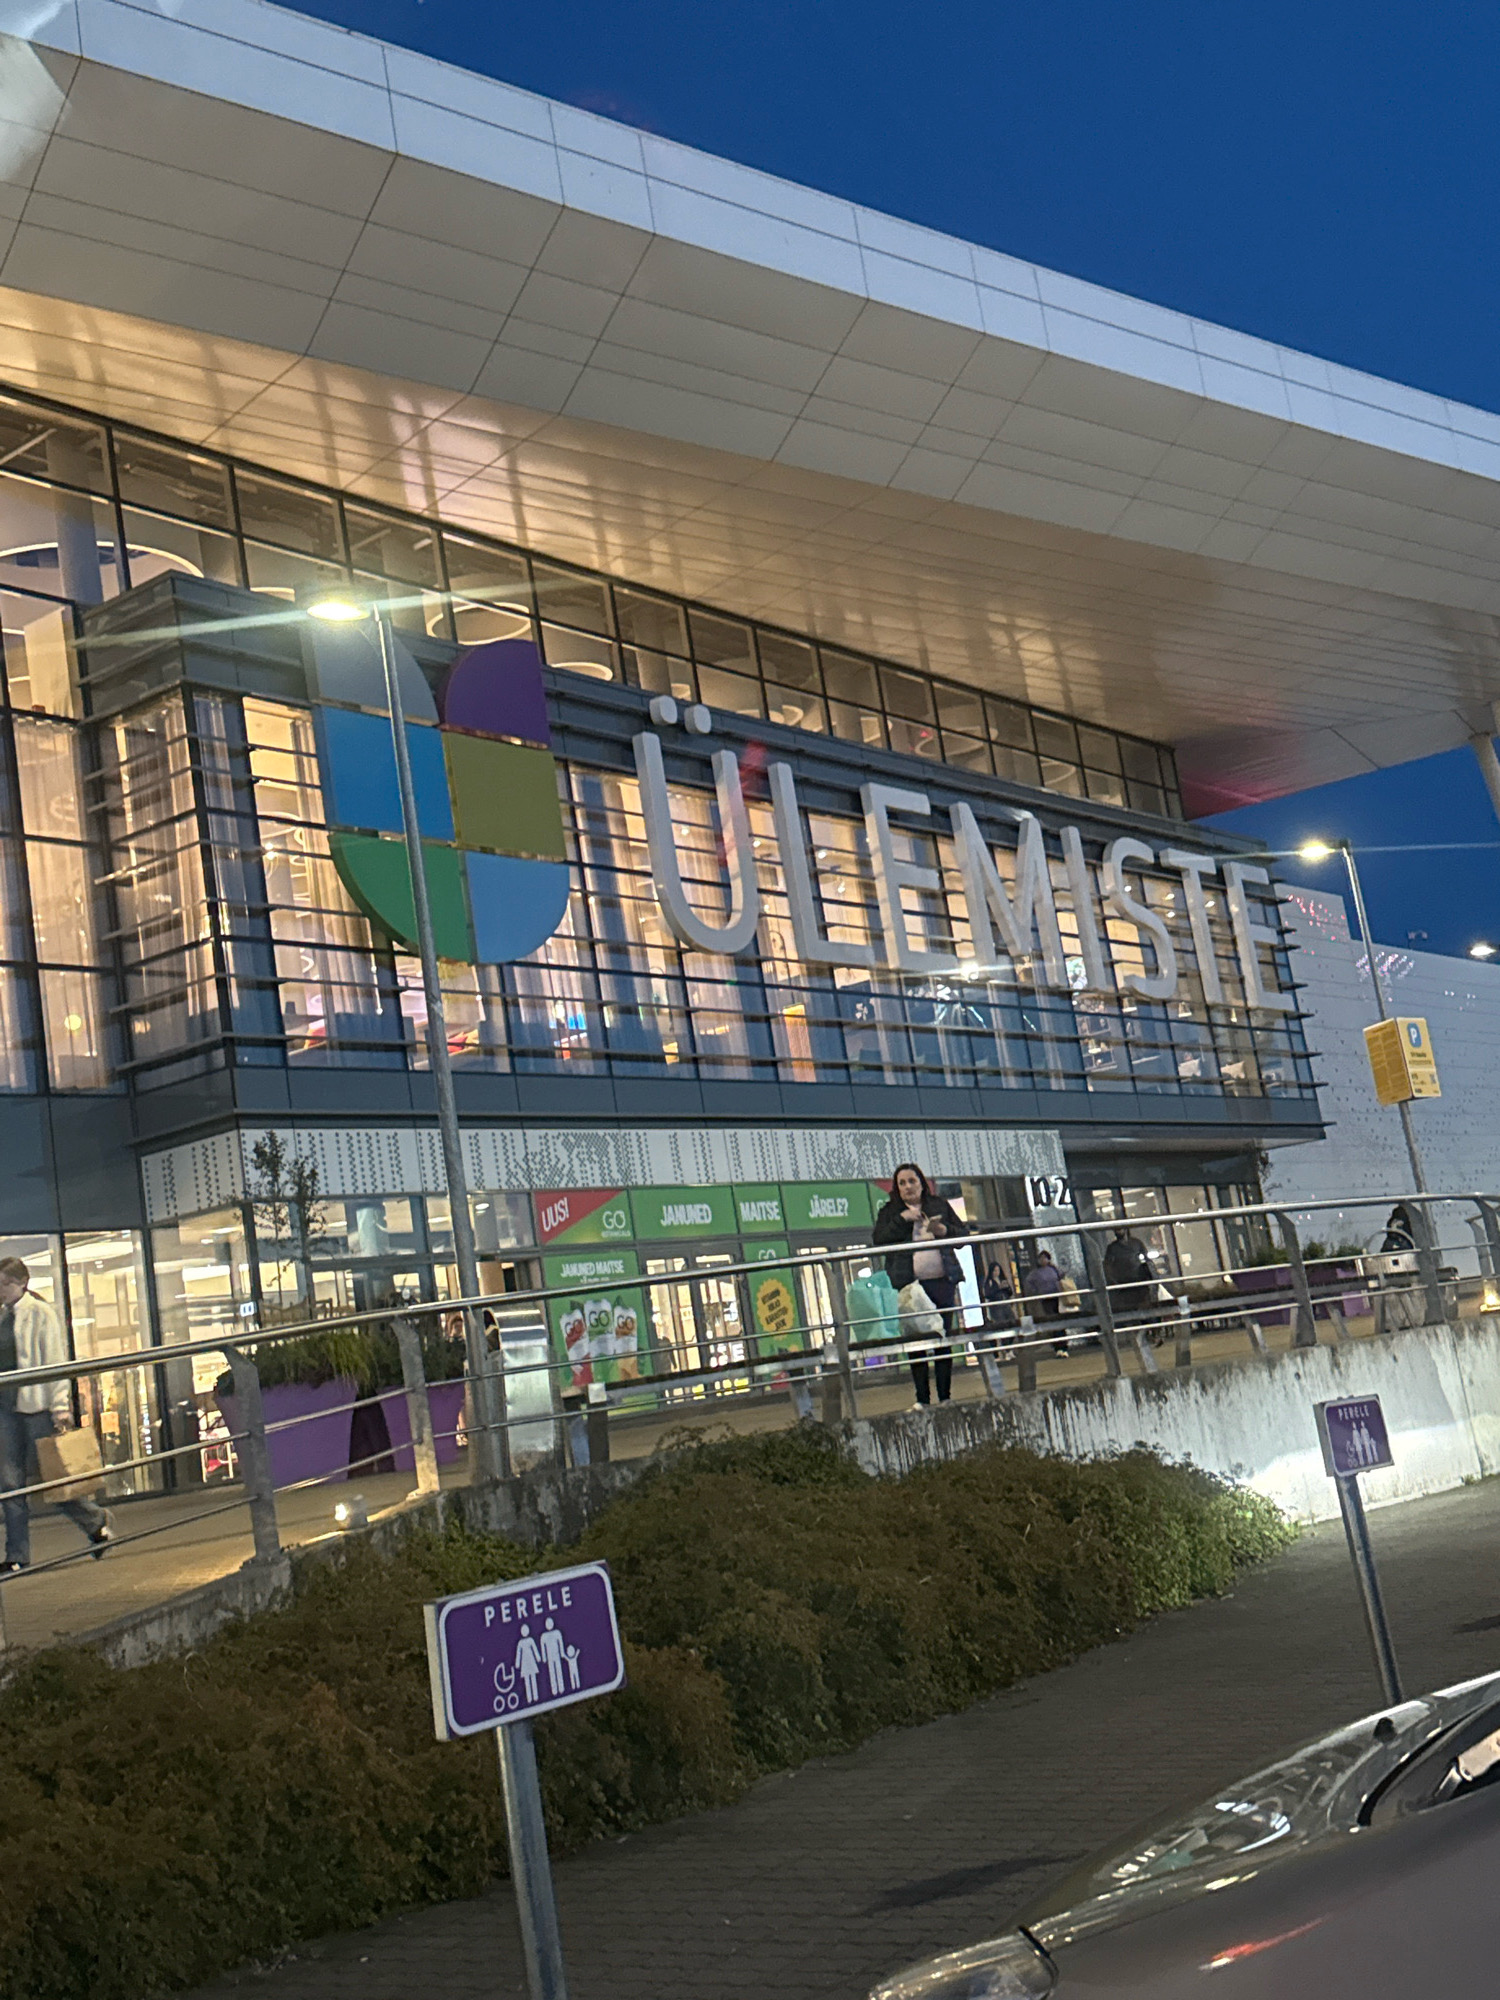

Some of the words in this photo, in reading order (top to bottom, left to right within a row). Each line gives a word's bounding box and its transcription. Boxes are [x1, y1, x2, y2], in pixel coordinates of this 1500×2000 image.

[632, 695, 1297, 1013] ÜLEMISTE
[1409, 1027, 1418, 1044] P
[541, 1196, 570, 1232] UUS!
[602, 1209, 626, 1230] GO
[739, 1200, 781, 1223] MAITSE
[808, 1194, 849, 1219] JÄRELE?
[588, 1310, 610, 1328] GO
[1337, 1404, 1370, 1421] PERELE
[484, 1586, 573, 1628] PERELE
